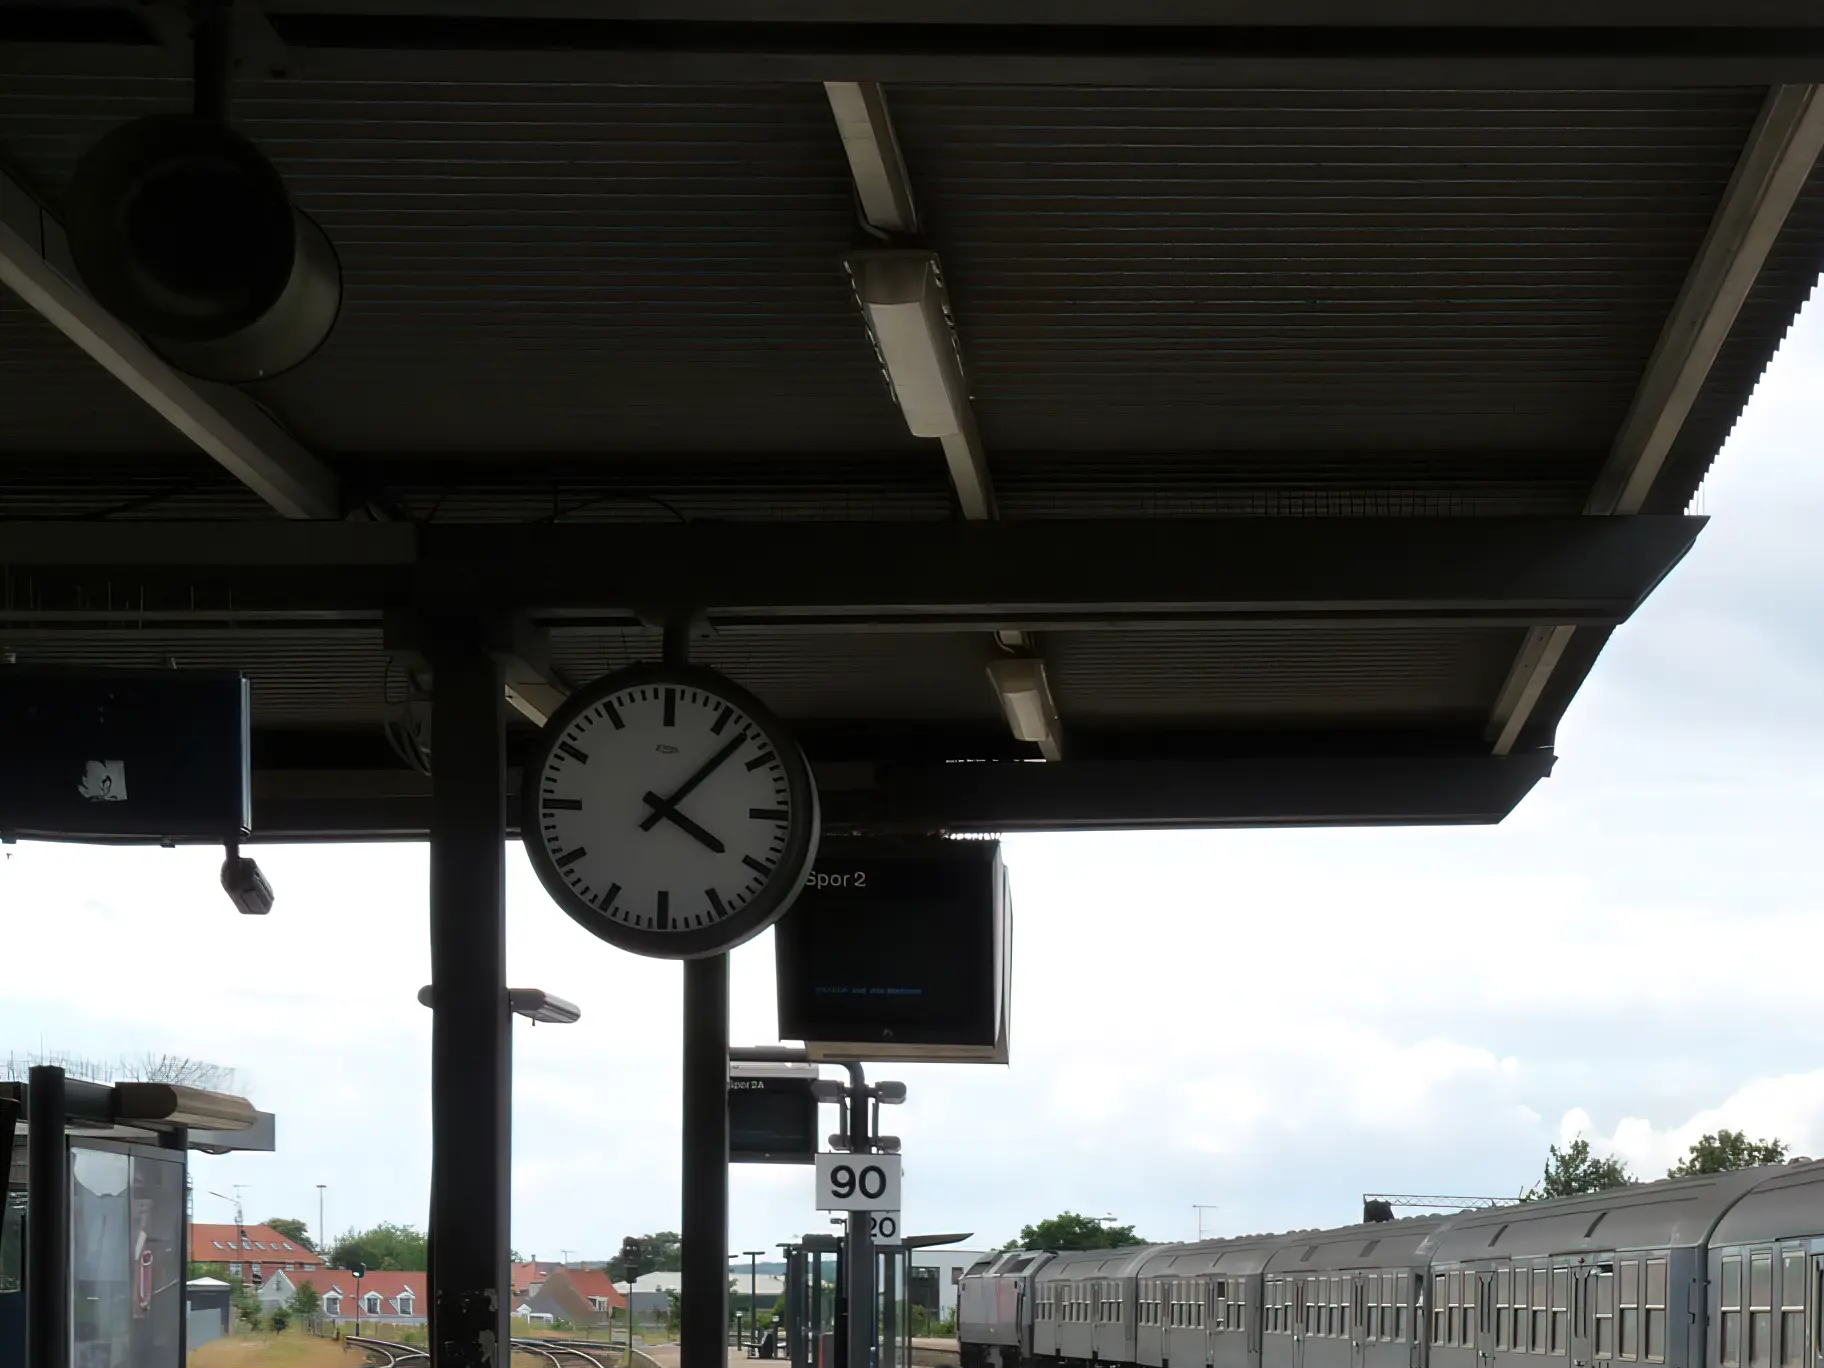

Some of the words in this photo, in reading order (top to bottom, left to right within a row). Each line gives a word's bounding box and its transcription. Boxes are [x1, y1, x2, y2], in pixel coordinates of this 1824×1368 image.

[805, 870, 850, 890] Spor
[854, 871, 867, 887] 2
[830, 1165, 886, 1199] 90
